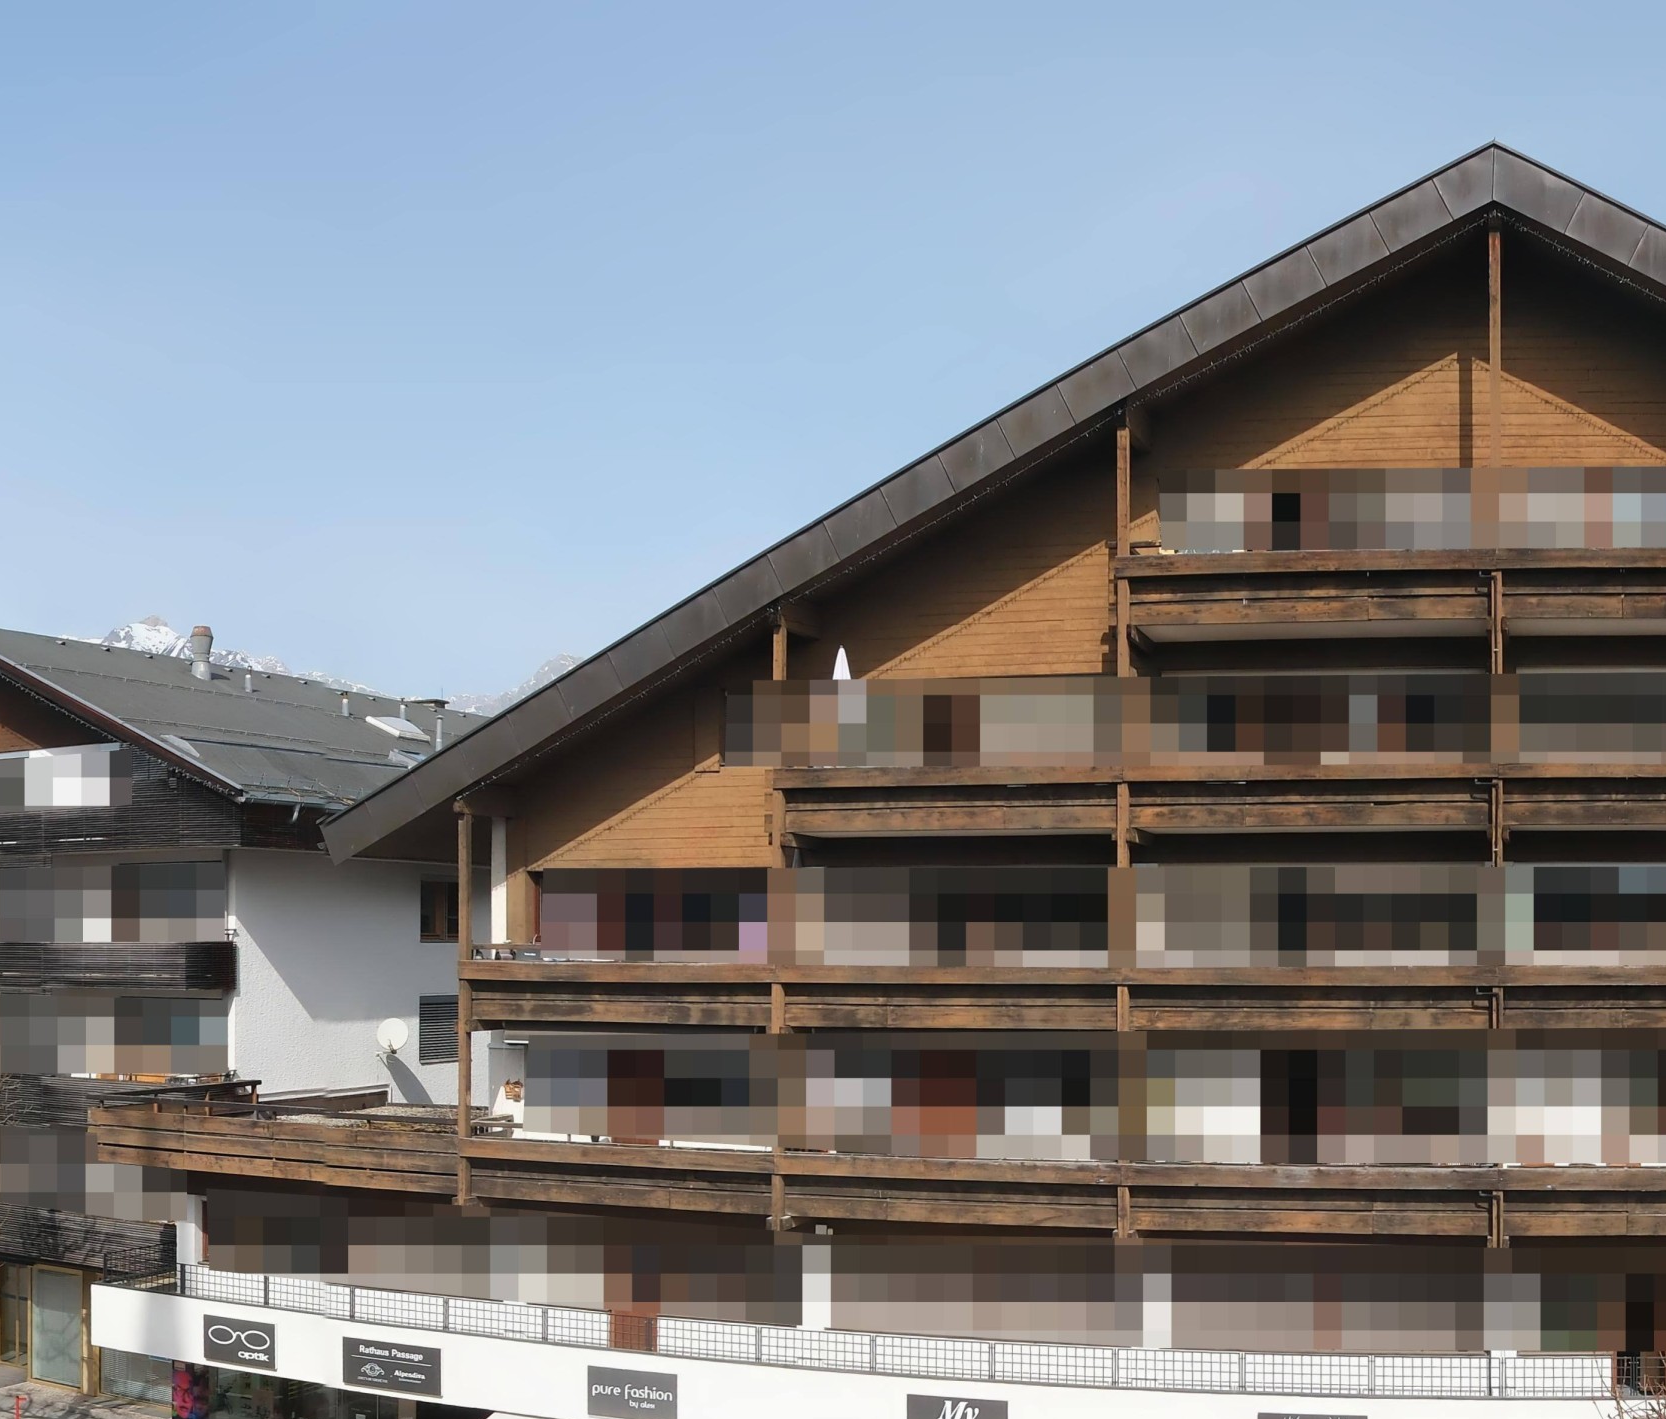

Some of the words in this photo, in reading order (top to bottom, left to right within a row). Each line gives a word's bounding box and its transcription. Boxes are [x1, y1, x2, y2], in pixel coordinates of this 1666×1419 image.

[238, 1350, 270, 1362] optik
[359, 1344, 389, 1357] Rathaus
[391, 1349, 424, 1362] Passage
[592, 1383, 621, 1396] pure
[624, 1383, 673, 1401] fashion
